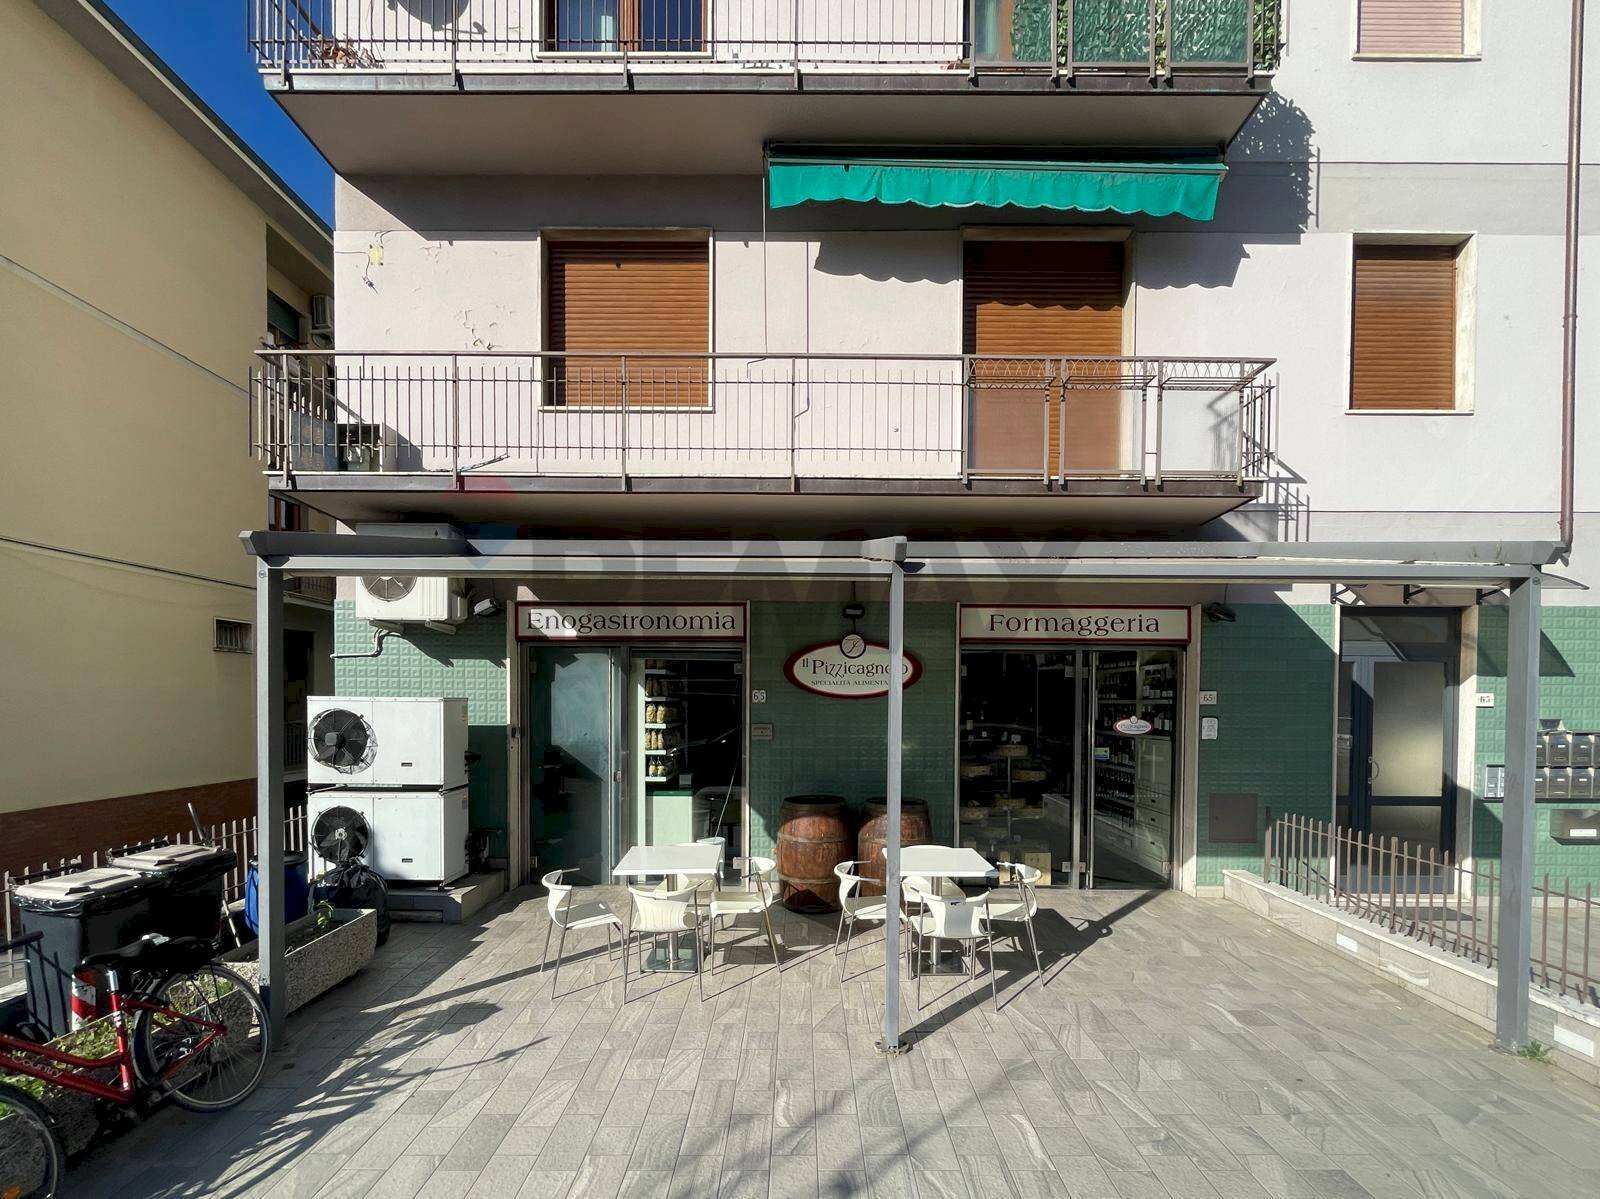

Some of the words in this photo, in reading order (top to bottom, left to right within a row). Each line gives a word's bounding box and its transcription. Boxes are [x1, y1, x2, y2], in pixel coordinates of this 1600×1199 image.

[526, 611, 736, 634] Enogastronomia
[989, 614, 1160, 637] Formaggeria
[802, 658, 809, 668] Il
[753, 691, 765, 701] 65
